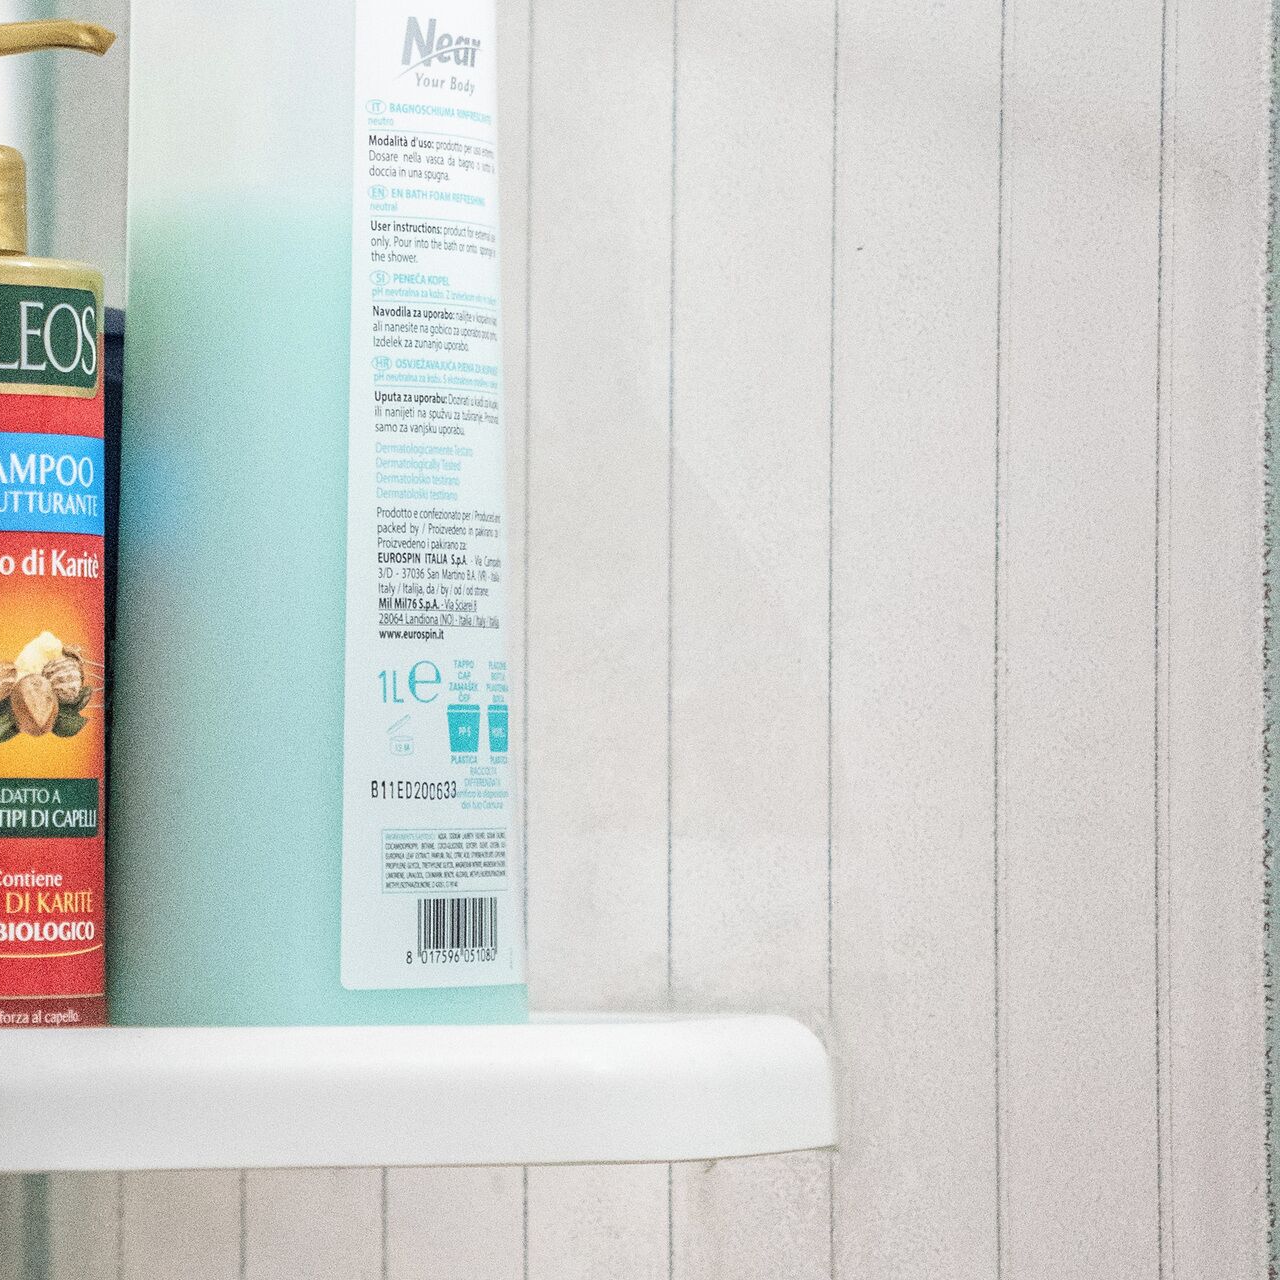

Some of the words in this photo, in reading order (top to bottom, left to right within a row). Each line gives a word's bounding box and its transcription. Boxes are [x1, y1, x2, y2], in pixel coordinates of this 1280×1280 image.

[401, 16, 480, 67] Near
[415, 72, 445, 89] Your
[450, 76, 475, 97] Body
[389, 102, 455, 118] BAGNOSCHIUMA
[368, 116, 394, 126] neutro
[368, 134, 408, 148] Modalità
[410, 136, 434, 149] d'uso:
[436, 139, 462, 153] prodotto
[368, 149, 398, 162] Dosare
[403, 151, 422, 164] nella
[425, 154, 444, 166] vasca
[447, 153, 456, 166] da
[458, 156, 474, 172] bagno
[369, 164, 396, 178] doccia
[399, 165, 406, 177] in
[408, 168, 423, 179] una
[391, 188, 403, 198] EN
[405, 188, 427, 199] BATH
[429, 190, 451, 201] FOAM
[370, 201, 398, 212] neutral
[370, 220, 391, 232] User
[393, 221, 442, 234] instructions:
[443, 225, 466, 239] product
[370, 235, 392, 250] only.
[394, 236, 412, 248] Pour
[414, 237, 429, 249] into
[430, 238, 441, 250] the
[443, 239, 458, 251] bath
[371, 250, 385, 262] the
[388, 251, 418, 263] shower.
[372, 287, 384, 299] pH
[372, 305, 411, 319] Navodila
[413, 308, 422, 319] za
[423, 308, 455, 321] uporabo:
[373, 320, 383, 332] ali
[384, 321, 418, 334] nanesite
[420, 323, 429, 333] na
[430, 324, 452, 337] gobico
[453, 327, 459, 336] za
[373, 335, 403, 348] Izdelek
[404, 339, 413, 348] za
[414, 338, 442, 352] zunanjo
[374, 390, 402, 404] Uputa
[403, 393, 412, 403] za
[414, 392, 447, 405] uporabu:
[374, 406, 382, 417] ili
[385, 406, 415, 420] nanijeti
[417, 409, 426, 418] na
[429, 408, 452, 422] spužvu
[453, 411, 460, 420] za
[375, 421, 398, 433] samo
[399, 423, 408, 433] za
[410, 422, 437, 436] vanjsku
[376, 506, 412, 519] Prodotto
[413, 510, 418, 518] e
[419, 507, 461, 521] confezionato
[377, 522, 407, 535] packed
[409, 522, 419, 536] by
[428, 523, 466, 536] Proizvedeno
[377, 537, 426, 549] Proizvedeno
[431, 538, 459, 551] pakirano
[21, 549, 45, 576] di
[51, 550, 99, 579] Karitè
[377, 552, 421, 564] EUROSPIN
[424, 553, 448, 564] ITALIA
[451, 554, 468, 568] S.p.A.
[377, 567, 393, 579] 3/D
[402, 567, 424, 579] 37036
[427, 568, 440, 580] San
[442, 568, 465, 581] Martino
[378, 582, 396, 597] Italy
[403, 582, 425, 597] Italija,
[426, 582, 435, 595] da
[440, 583, 448, 598] by
[378, 597, 392, 609] Mil
[418, 598, 440, 612] S.p.A.
[444, 598, 454, 610] Via
[378, 613, 404, 624] 28064
[405, 613, 438, 625] Landiona
[378, 629, 444, 642] www.eurospin.it
[52, 789, 61, 804] A
[371, 780, 457, 800] B11ED200633
[31, 809, 49, 828] DI
[52, 809, 97, 828] CAPELLI
[5, 891, 30, 913] DI
[406, 950, 412, 964] 8
[421, 949, 460, 964] 017596
[464, 948, 496, 963] 051080
[0, 1010, 28, 1024] forza
[31, 1010, 42, 1024] al
